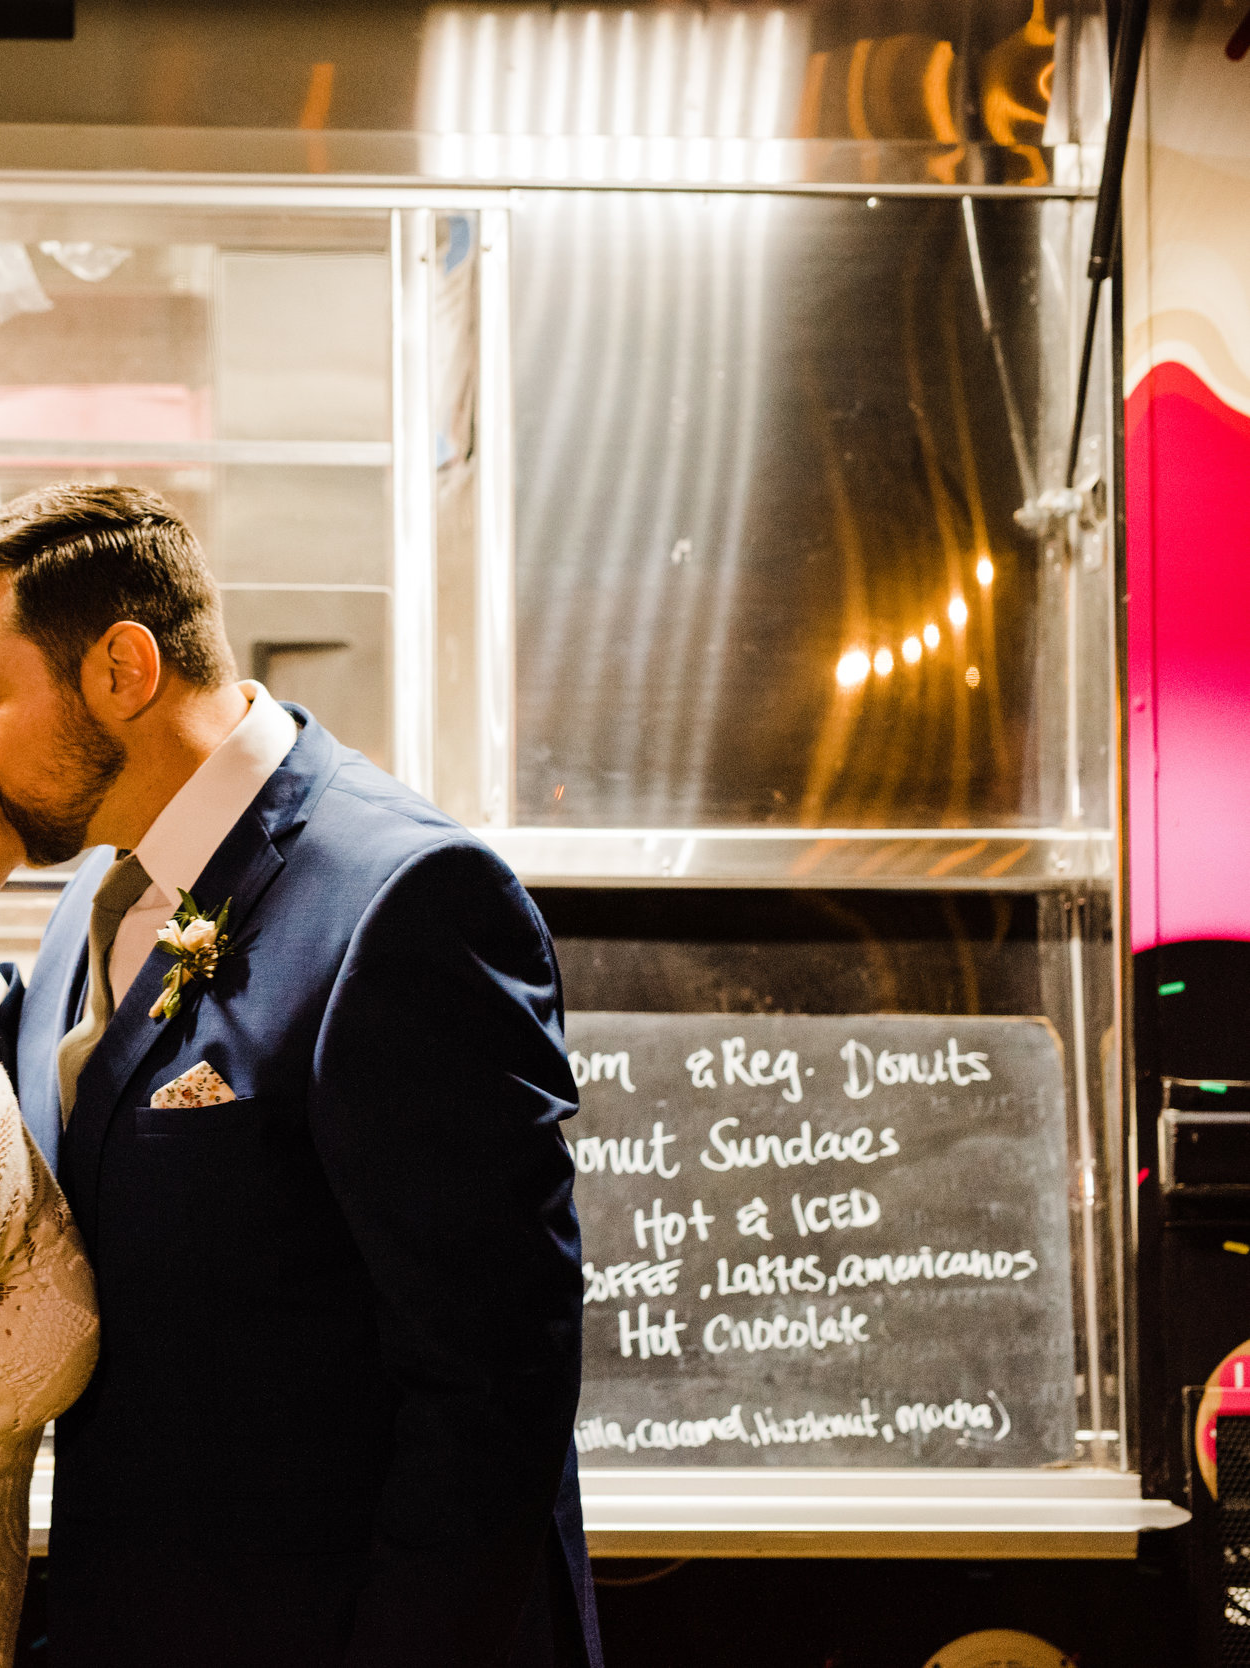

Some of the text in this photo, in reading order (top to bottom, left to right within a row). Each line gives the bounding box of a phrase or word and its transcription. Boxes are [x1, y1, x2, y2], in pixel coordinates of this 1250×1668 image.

[568, 1050, 637, 1093] om
[841, 1037, 992, 1099] Donuts
[700, 1116, 901, 1173] Sundaes
[634, 1197, 715, 1261] Hot
[791, 1188, 881, 1238] ICED
[618, 1303, 869, 1360] Hot Chocolate
